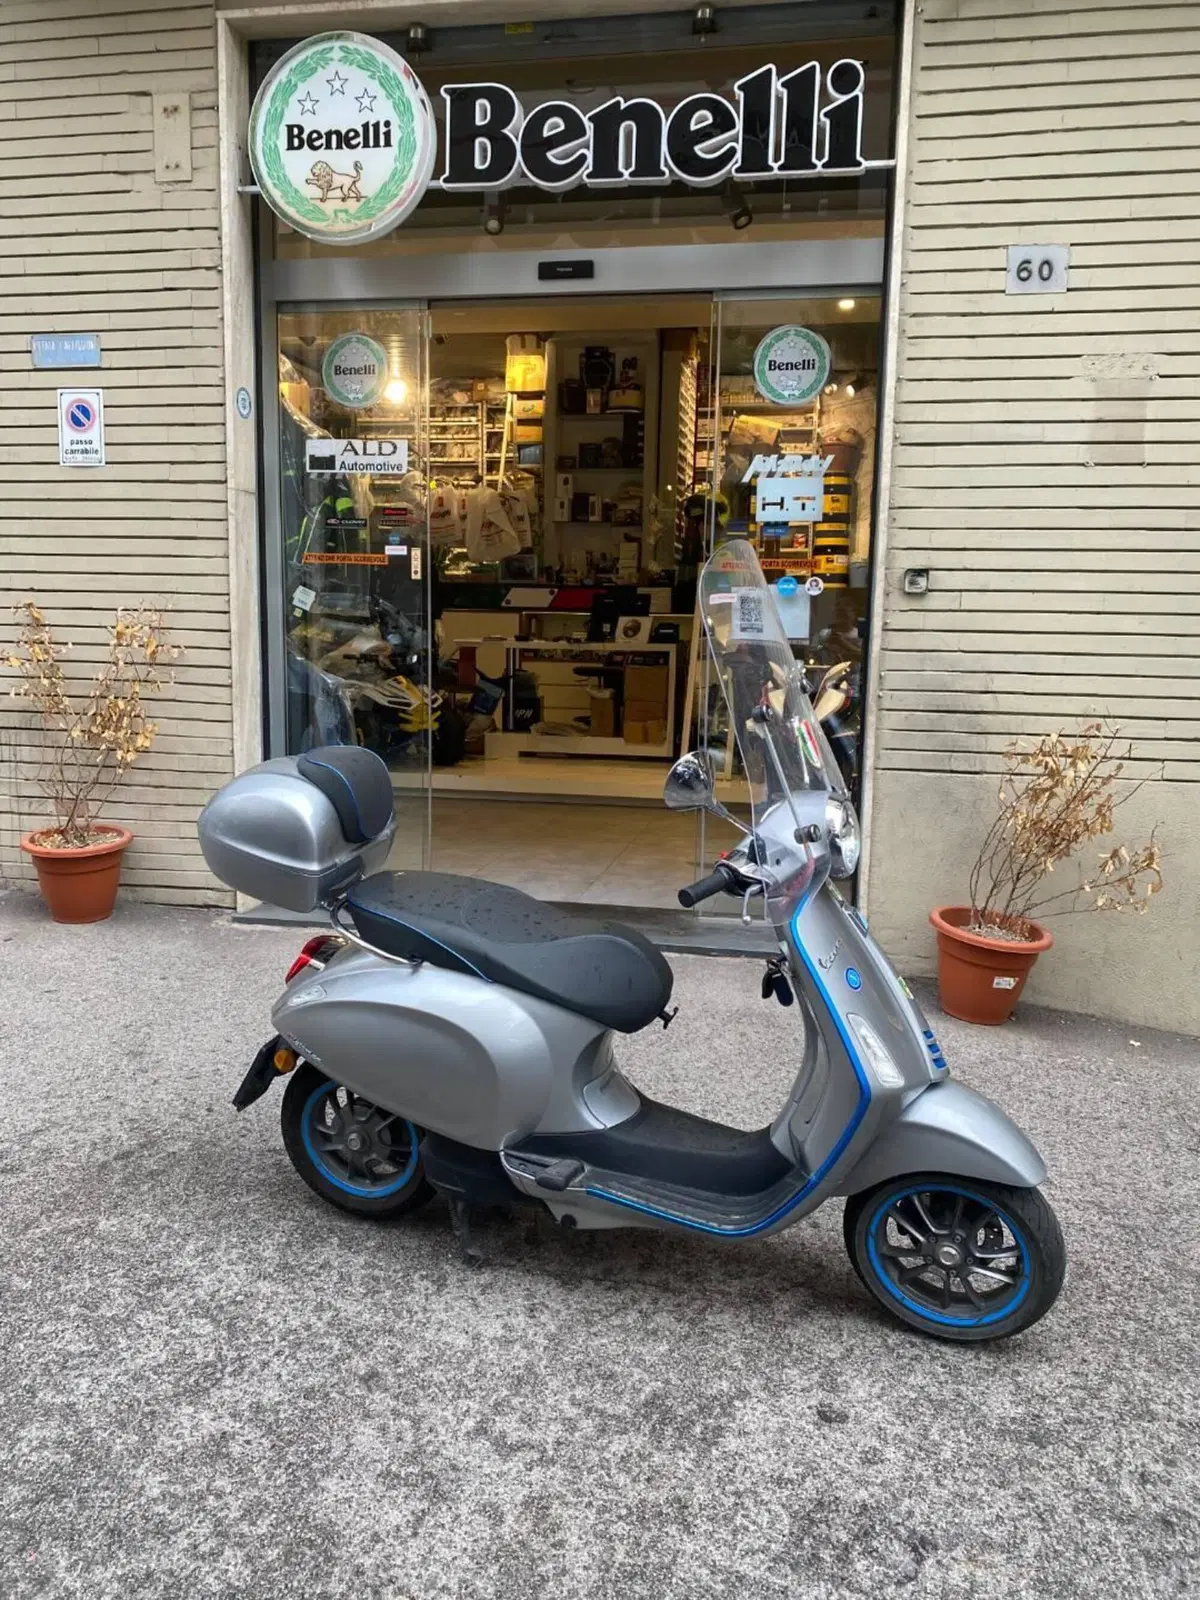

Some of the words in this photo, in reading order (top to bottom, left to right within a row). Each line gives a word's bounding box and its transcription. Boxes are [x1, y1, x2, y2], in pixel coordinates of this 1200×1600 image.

[441, 58, 866, 191] Benelli
[285, 119, 394, 152] Benelli
[1015, 259, 1055, 282] 60
[334, 364, 376, 376] Benelli
[768, 358, 816, 371] Benelli
[70, 439, 93, 447] passo
[340, 440, 398, 456] ALD
[64, 447, 99, 455] carrabile
[339, 460, 403, 471] Automotive
[761, 559, 780, 569] PORTA
[781, 559, 817, 569] SCORREVOLE
